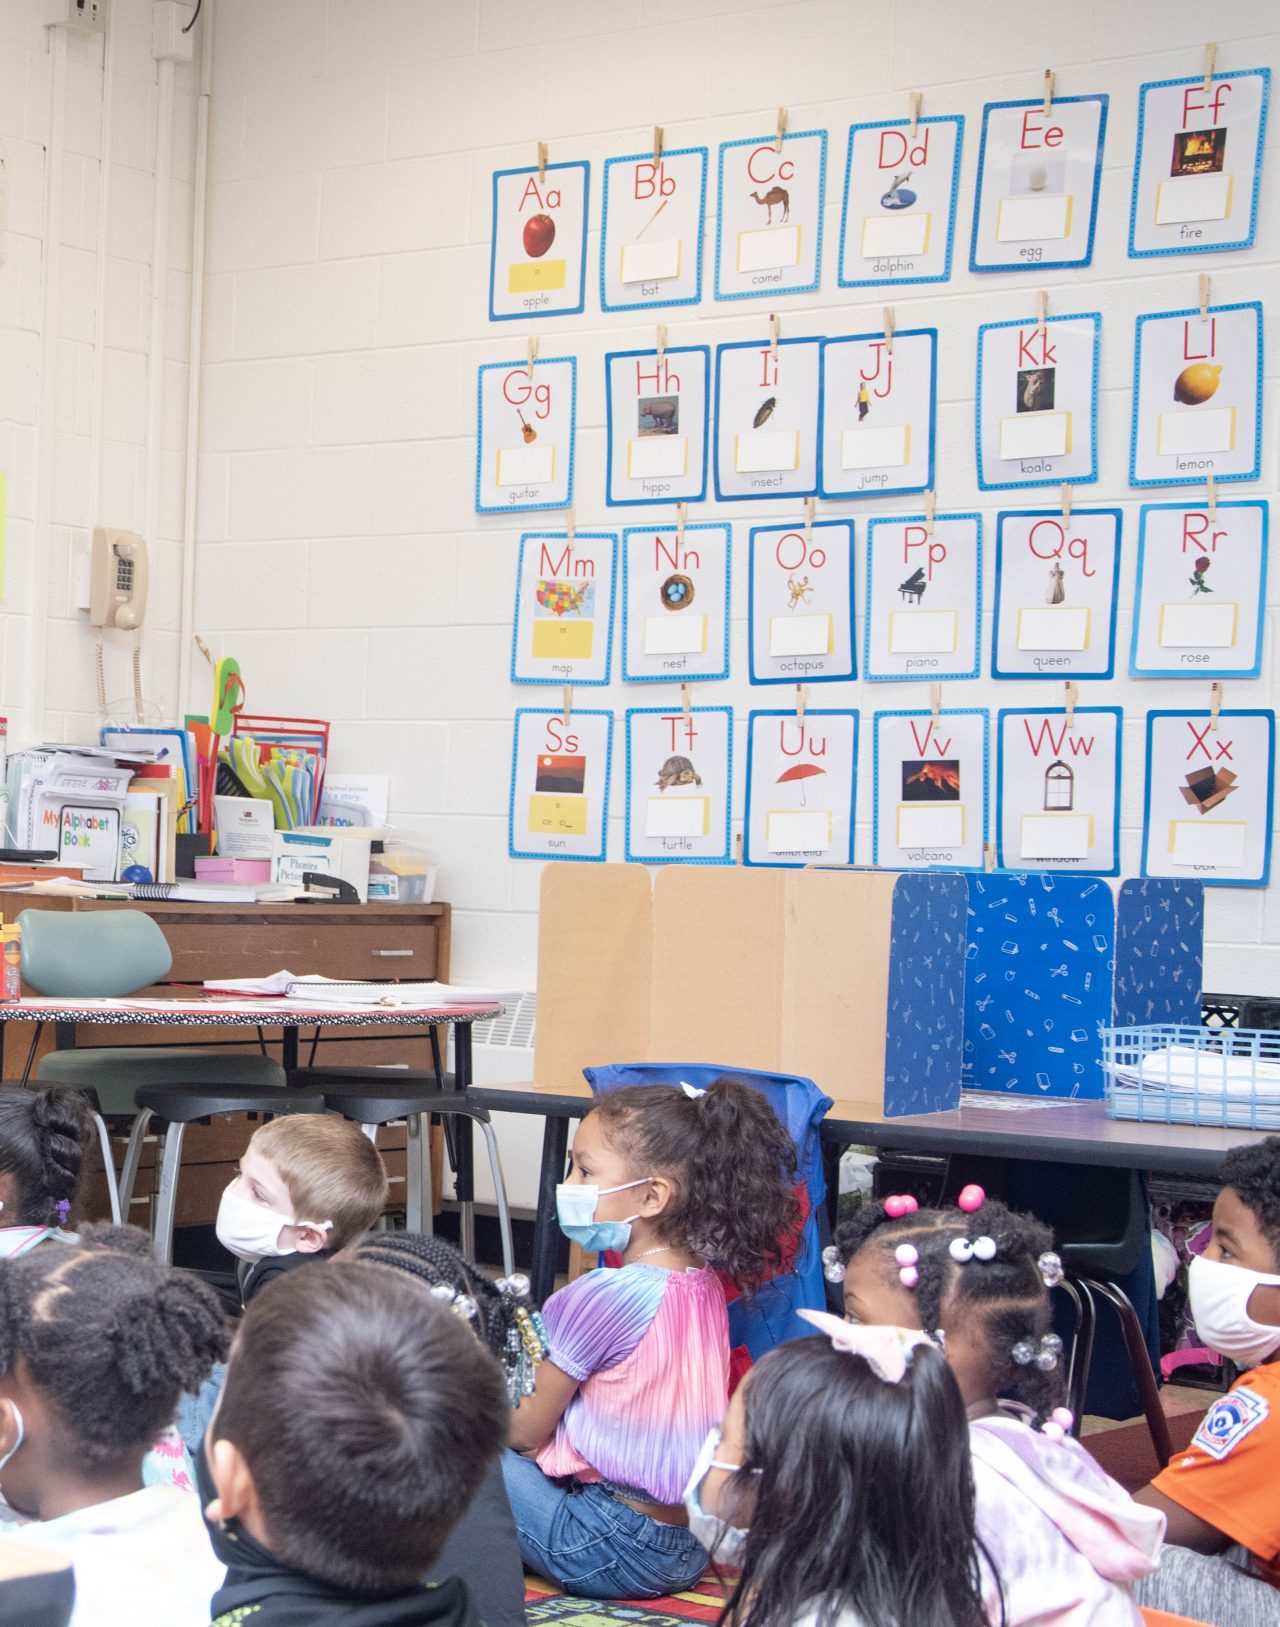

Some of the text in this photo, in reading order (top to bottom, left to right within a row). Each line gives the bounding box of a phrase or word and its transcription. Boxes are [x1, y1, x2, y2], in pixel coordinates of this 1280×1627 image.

[1182, 84, 1232, 129] Ff
[1020, 110, 1064, 149] Ee
[878, 128, 929, 169] Dd
[747, 147, 795, 184] Cc
[634, 162, 676, 200] Bb
[519, 177, 561, 212] Aa
[1179, 224, 1203, 241] fire
[1019, 246, 1043, 262] egg
[751, 269, 783, 285] camel
[872, 259, 915, 277] dolphin
[641, 282, 660, 296] bat
[522, 294, 550, 312] apple
[1018, 327, 1057, 368] Kk
[636, 359, 680, 395] Hh
[758, 350, 779, 387] Ii
[860, 343, 893, 399] Jj
[502, 370, 551, 419] Gg
[1020, 460, 1052, 474] koala
[1175, 457, 1214, 471] lemon
[642, 480, 671, 496] hippo
[750, 473, 784, 489] insect
[856, 472, 889, 491] jump
[508, 486, 540, 505] guitar
[1182, 513, 1228, 554] Rr
[655, 535, 700, 571] Nn
[776, 533, 826, 570] Oo
[904, 526, 947, 581] Pp
[1028, 520, 1096, 577] Qq
[539, 542, 595, 577] Mm
[663, 656, 688, 669] nest
[780, 658, 825, 674] octopus
[905, 656, 939, 671] piano
[1033, 654, 1072, 672] queen
[1180, 652, 1210, 664] rose
[551, 664, 573, 678] map
[545, 717, 580, 753] Ss
[660, 716, 698, 752] Tt
[780, 720, 827, 756] Uu
[910, 720, 952, 757] Vv
[1023, 718, 1095, 757] Ww
[1186, 721, 1234, 761] Xx
[43, 809, 110, 831] My Alphabet
[63, 830, 91, 848] Book
[548, 839, 567, 849] sun
[662, 838, 693, 851] turtle
[290, 857, 318, 870] Phonics
[907, 848, 953, 862] volcano
[280, 869, 303, 881] Pictur
